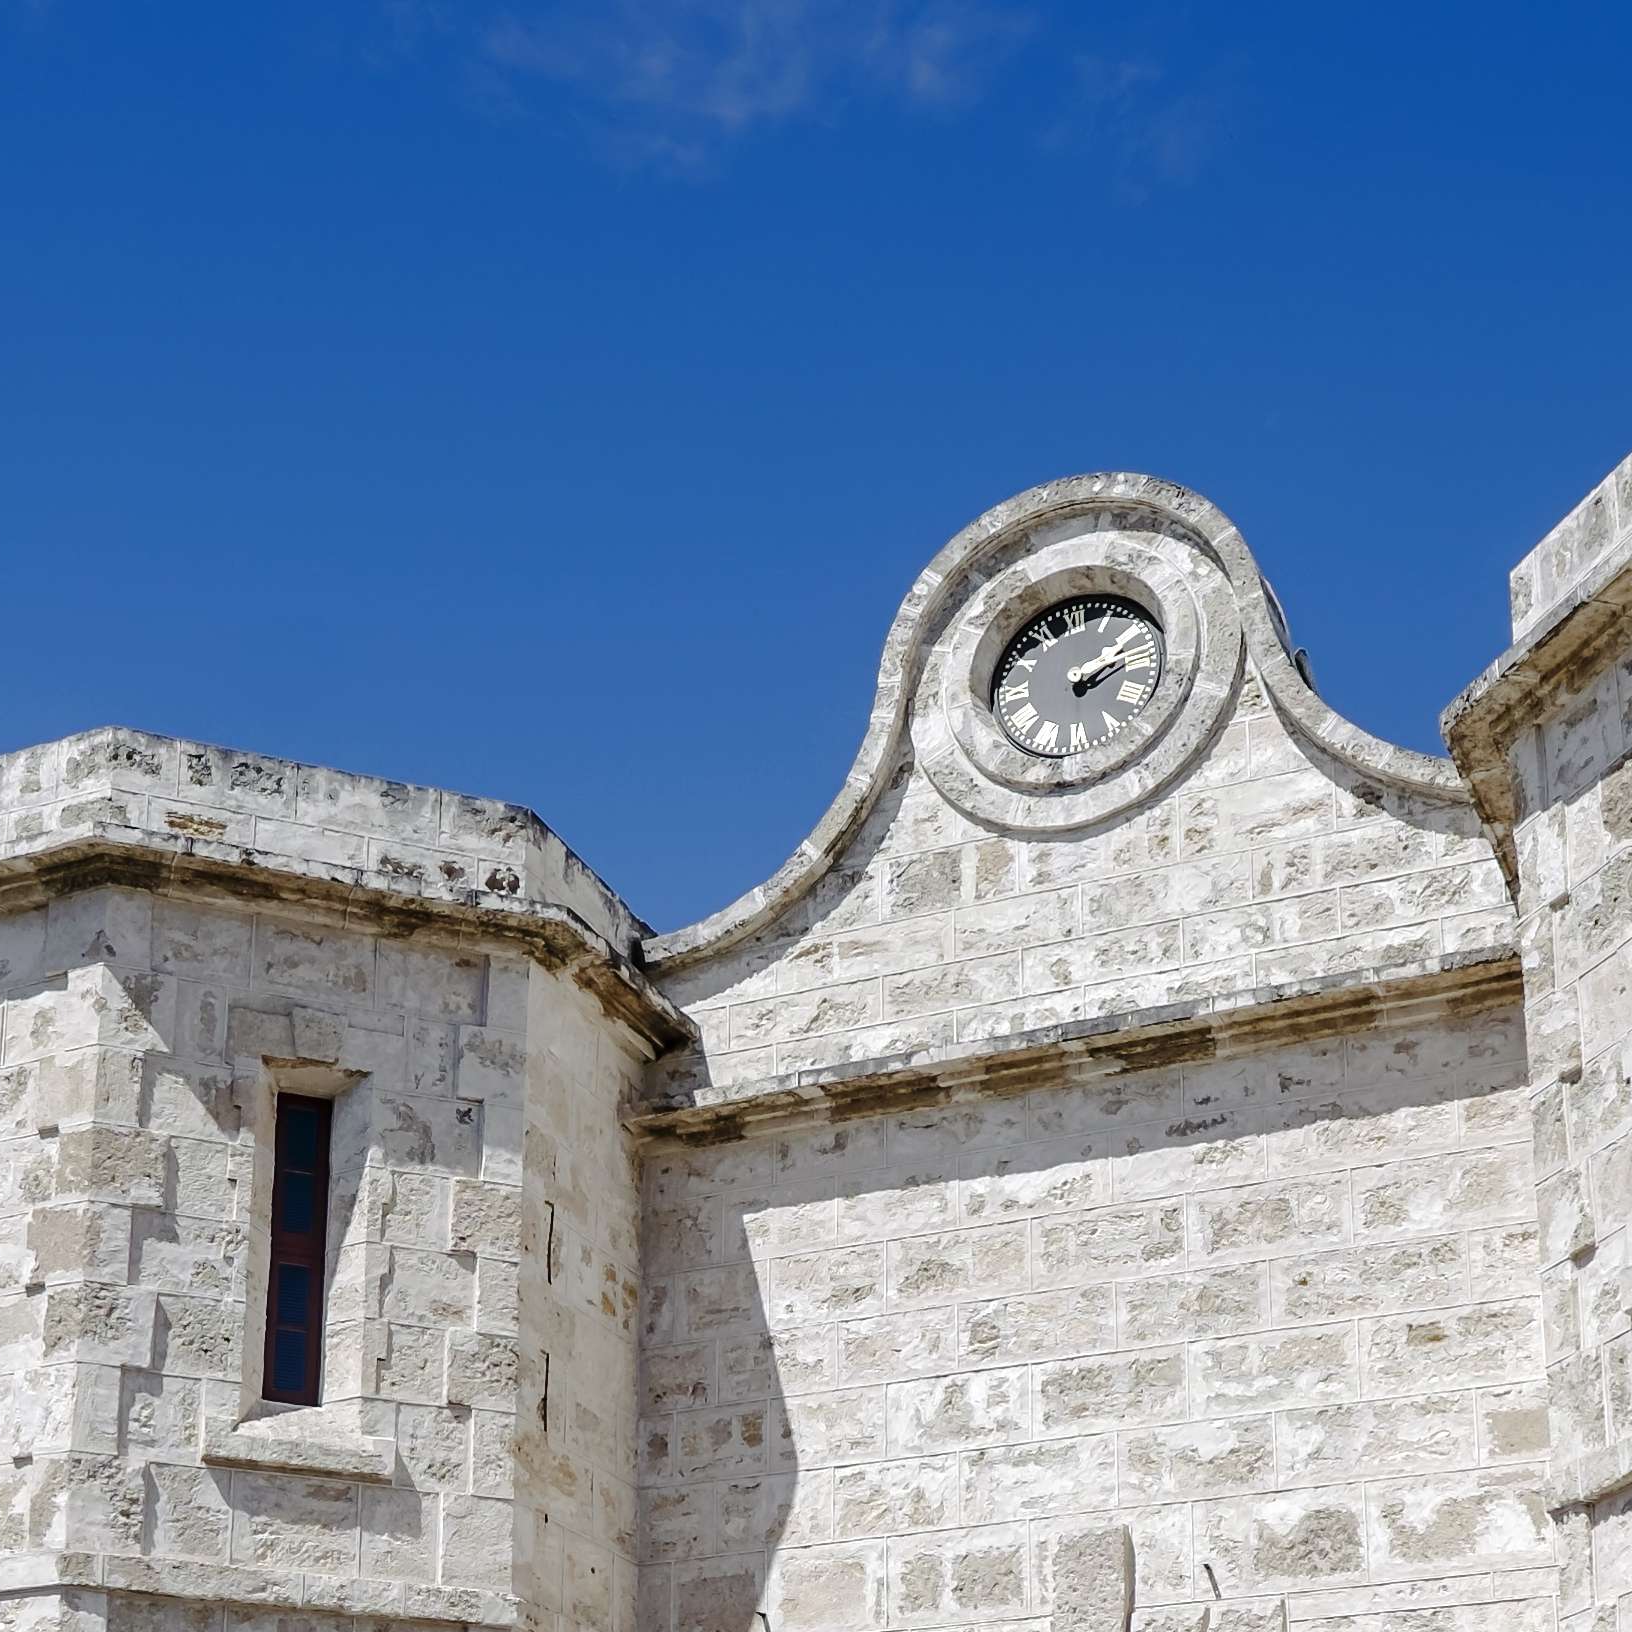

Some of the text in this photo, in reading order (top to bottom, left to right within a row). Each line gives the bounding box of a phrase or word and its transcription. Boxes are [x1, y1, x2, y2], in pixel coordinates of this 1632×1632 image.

[1063, 609, 1086, 637] XII
[1097, 610, 1113, 633] I
[1032, 625, 1059, 652] XI
[1012, 656, 1038, 672] X
